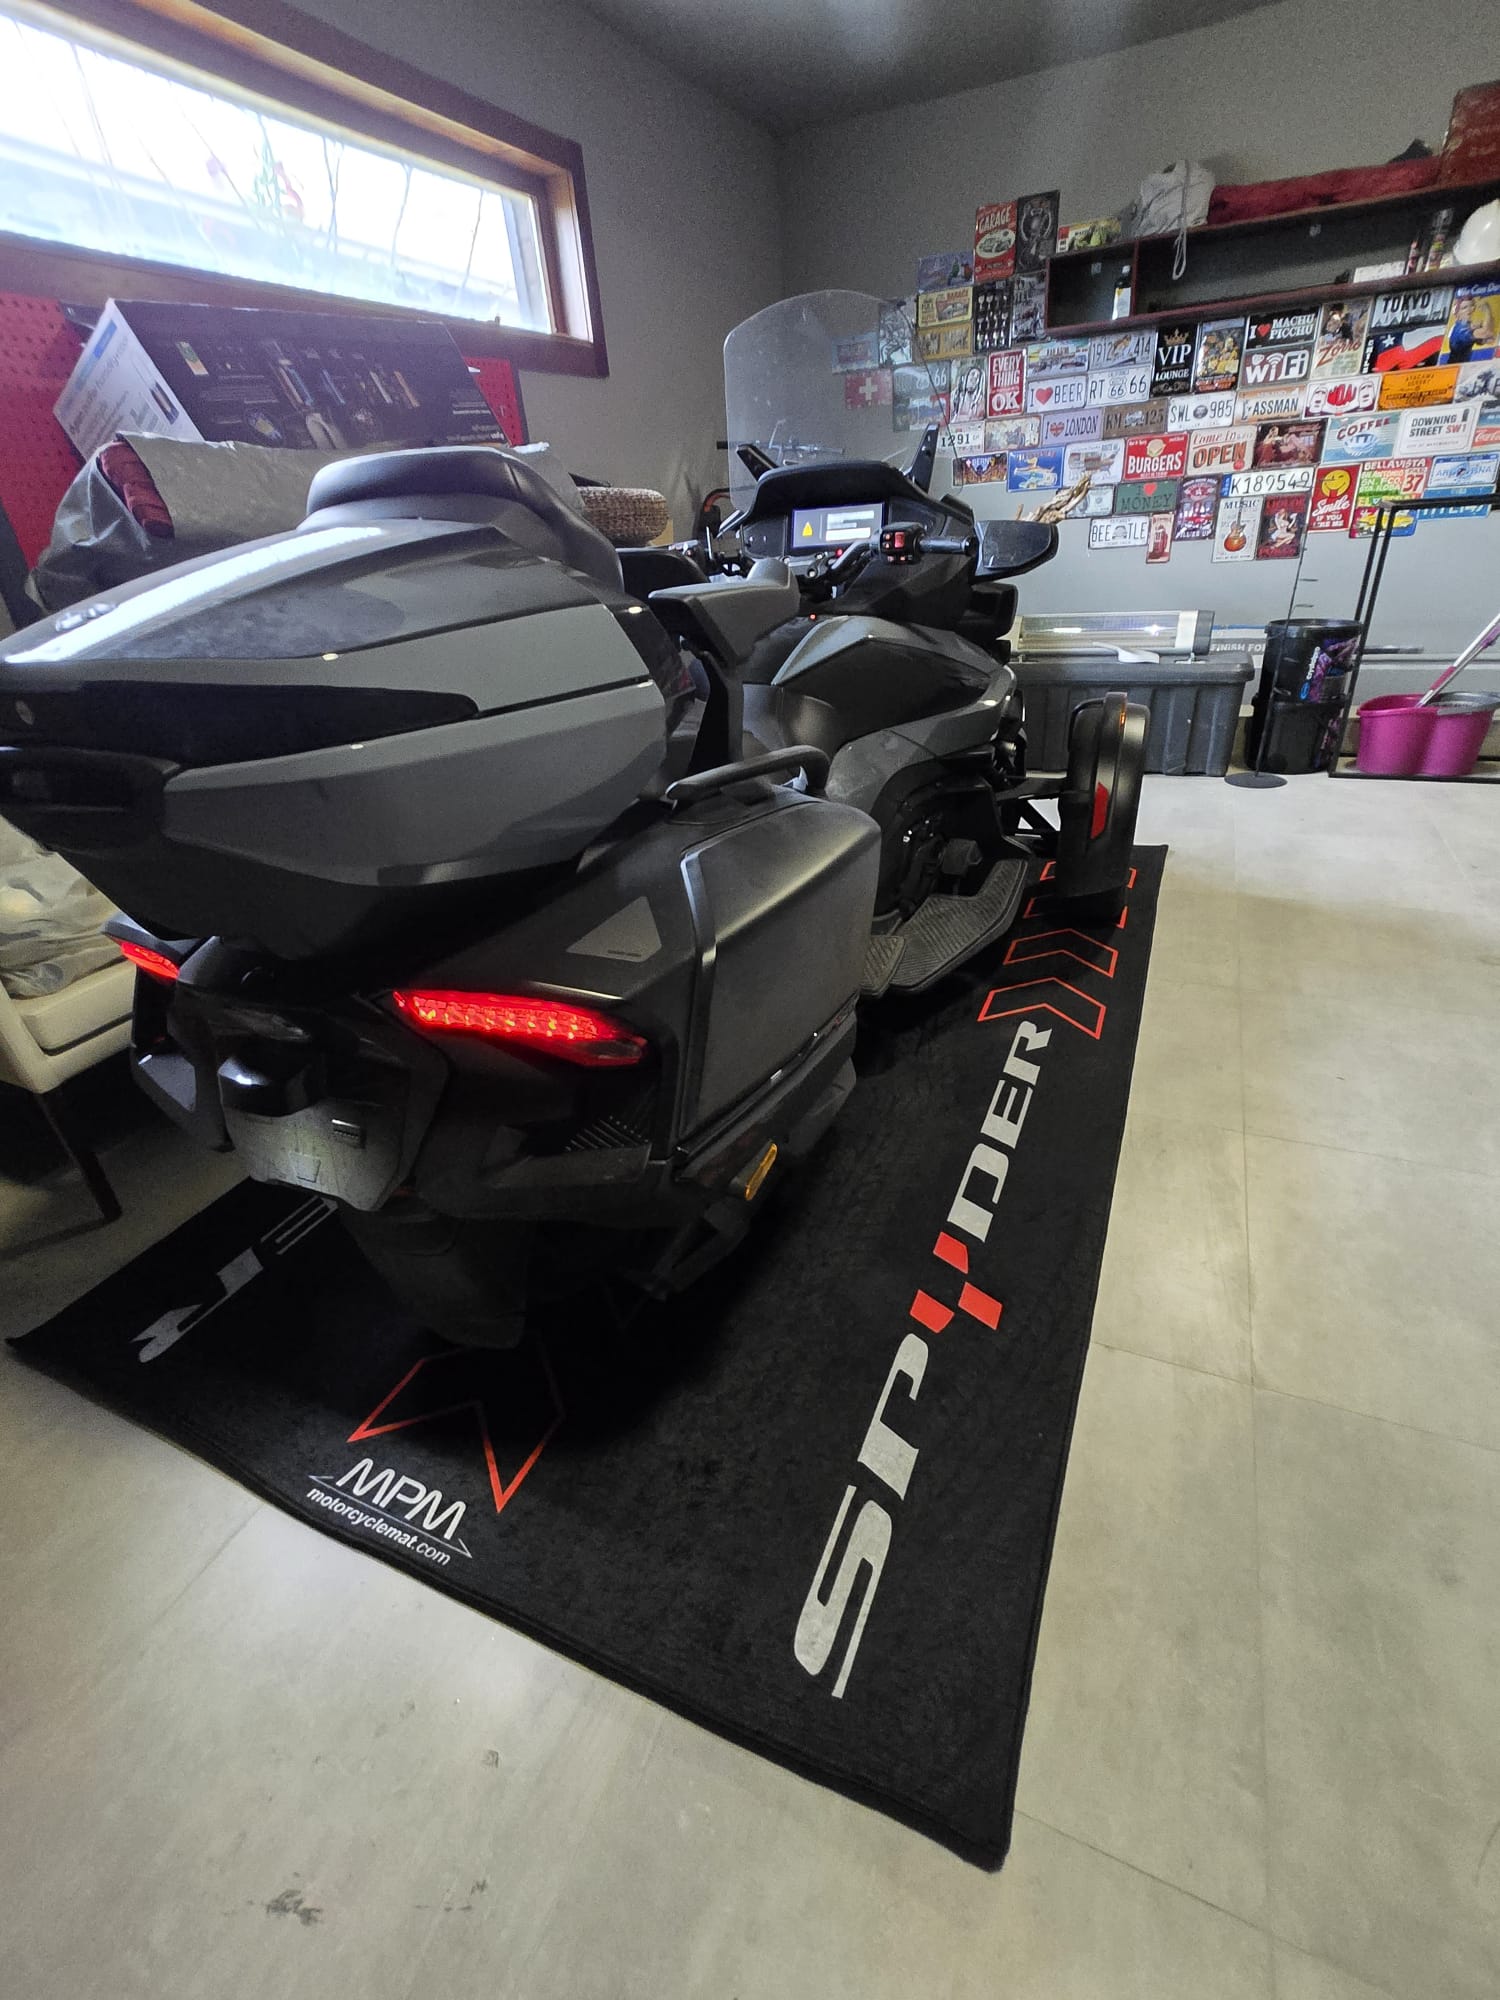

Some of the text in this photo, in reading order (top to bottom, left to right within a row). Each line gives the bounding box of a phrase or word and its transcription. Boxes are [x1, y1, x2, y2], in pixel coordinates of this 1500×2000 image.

[978, 206, 1013, 233] GARAGE
[1383, 292, 1431, 313] TOKYO
[1249, 323, 1314, 340] I PICCHU
[1272, 313, 1316, 329] MACHU
[1092, 341, 1113, 364] 1912
[1134, 335, 1152, 358] 414
[1158, 344, 1192, 366] VIP
[1316, 338, 1362, 368] Zorro
[992, 354, 1021, 372] EVERY
[1246, 350, 1308, 384] WiFi
[993, 367, 1020, 388] THING
[1155, 368, 1190, 381] LOUNGE
[1029, 382, 1083, 407] I BEER
[1089, 379, 1106, 400] RT
[1129, 374, 1147, 394] 66
[991, 390, 1020, 412] OK
[1170, 399, 1233, 423] SWL 985
[1252, 397, 1299, 415] ASSMAN
[1044, 415, 1098, 440] I LONDON
[1105, 412, 1122, 430] KM
[1144, 408, 1164, 425] 125
[1336, 418, 1391, 441] COFFEE
[1411, 414, 1457, 427] DOWNING
[941, 433, 970, 447] 1291
[1193, 433, 1222, 445] Come
[1409, 425, 1443, 438] STREET
[1127, 452, 1183, 475] BURGERS
[1193, 442, 1247, 468] OPEN
[1364, 458, 1426, 470] BELLAVISTA
[1403, 474, 1424, 492] 37
[1121, 494, 1173, 513] MONEY
[1223, 499, 1260, 510] MUSIC
[1312, 495, 1351, 517] Smile
[1210, 643, 1246, 652] FINISH
[336, 1457, 467, 1540] MPM
[306, 1487, 452, 1566] motorcyclemat.com
